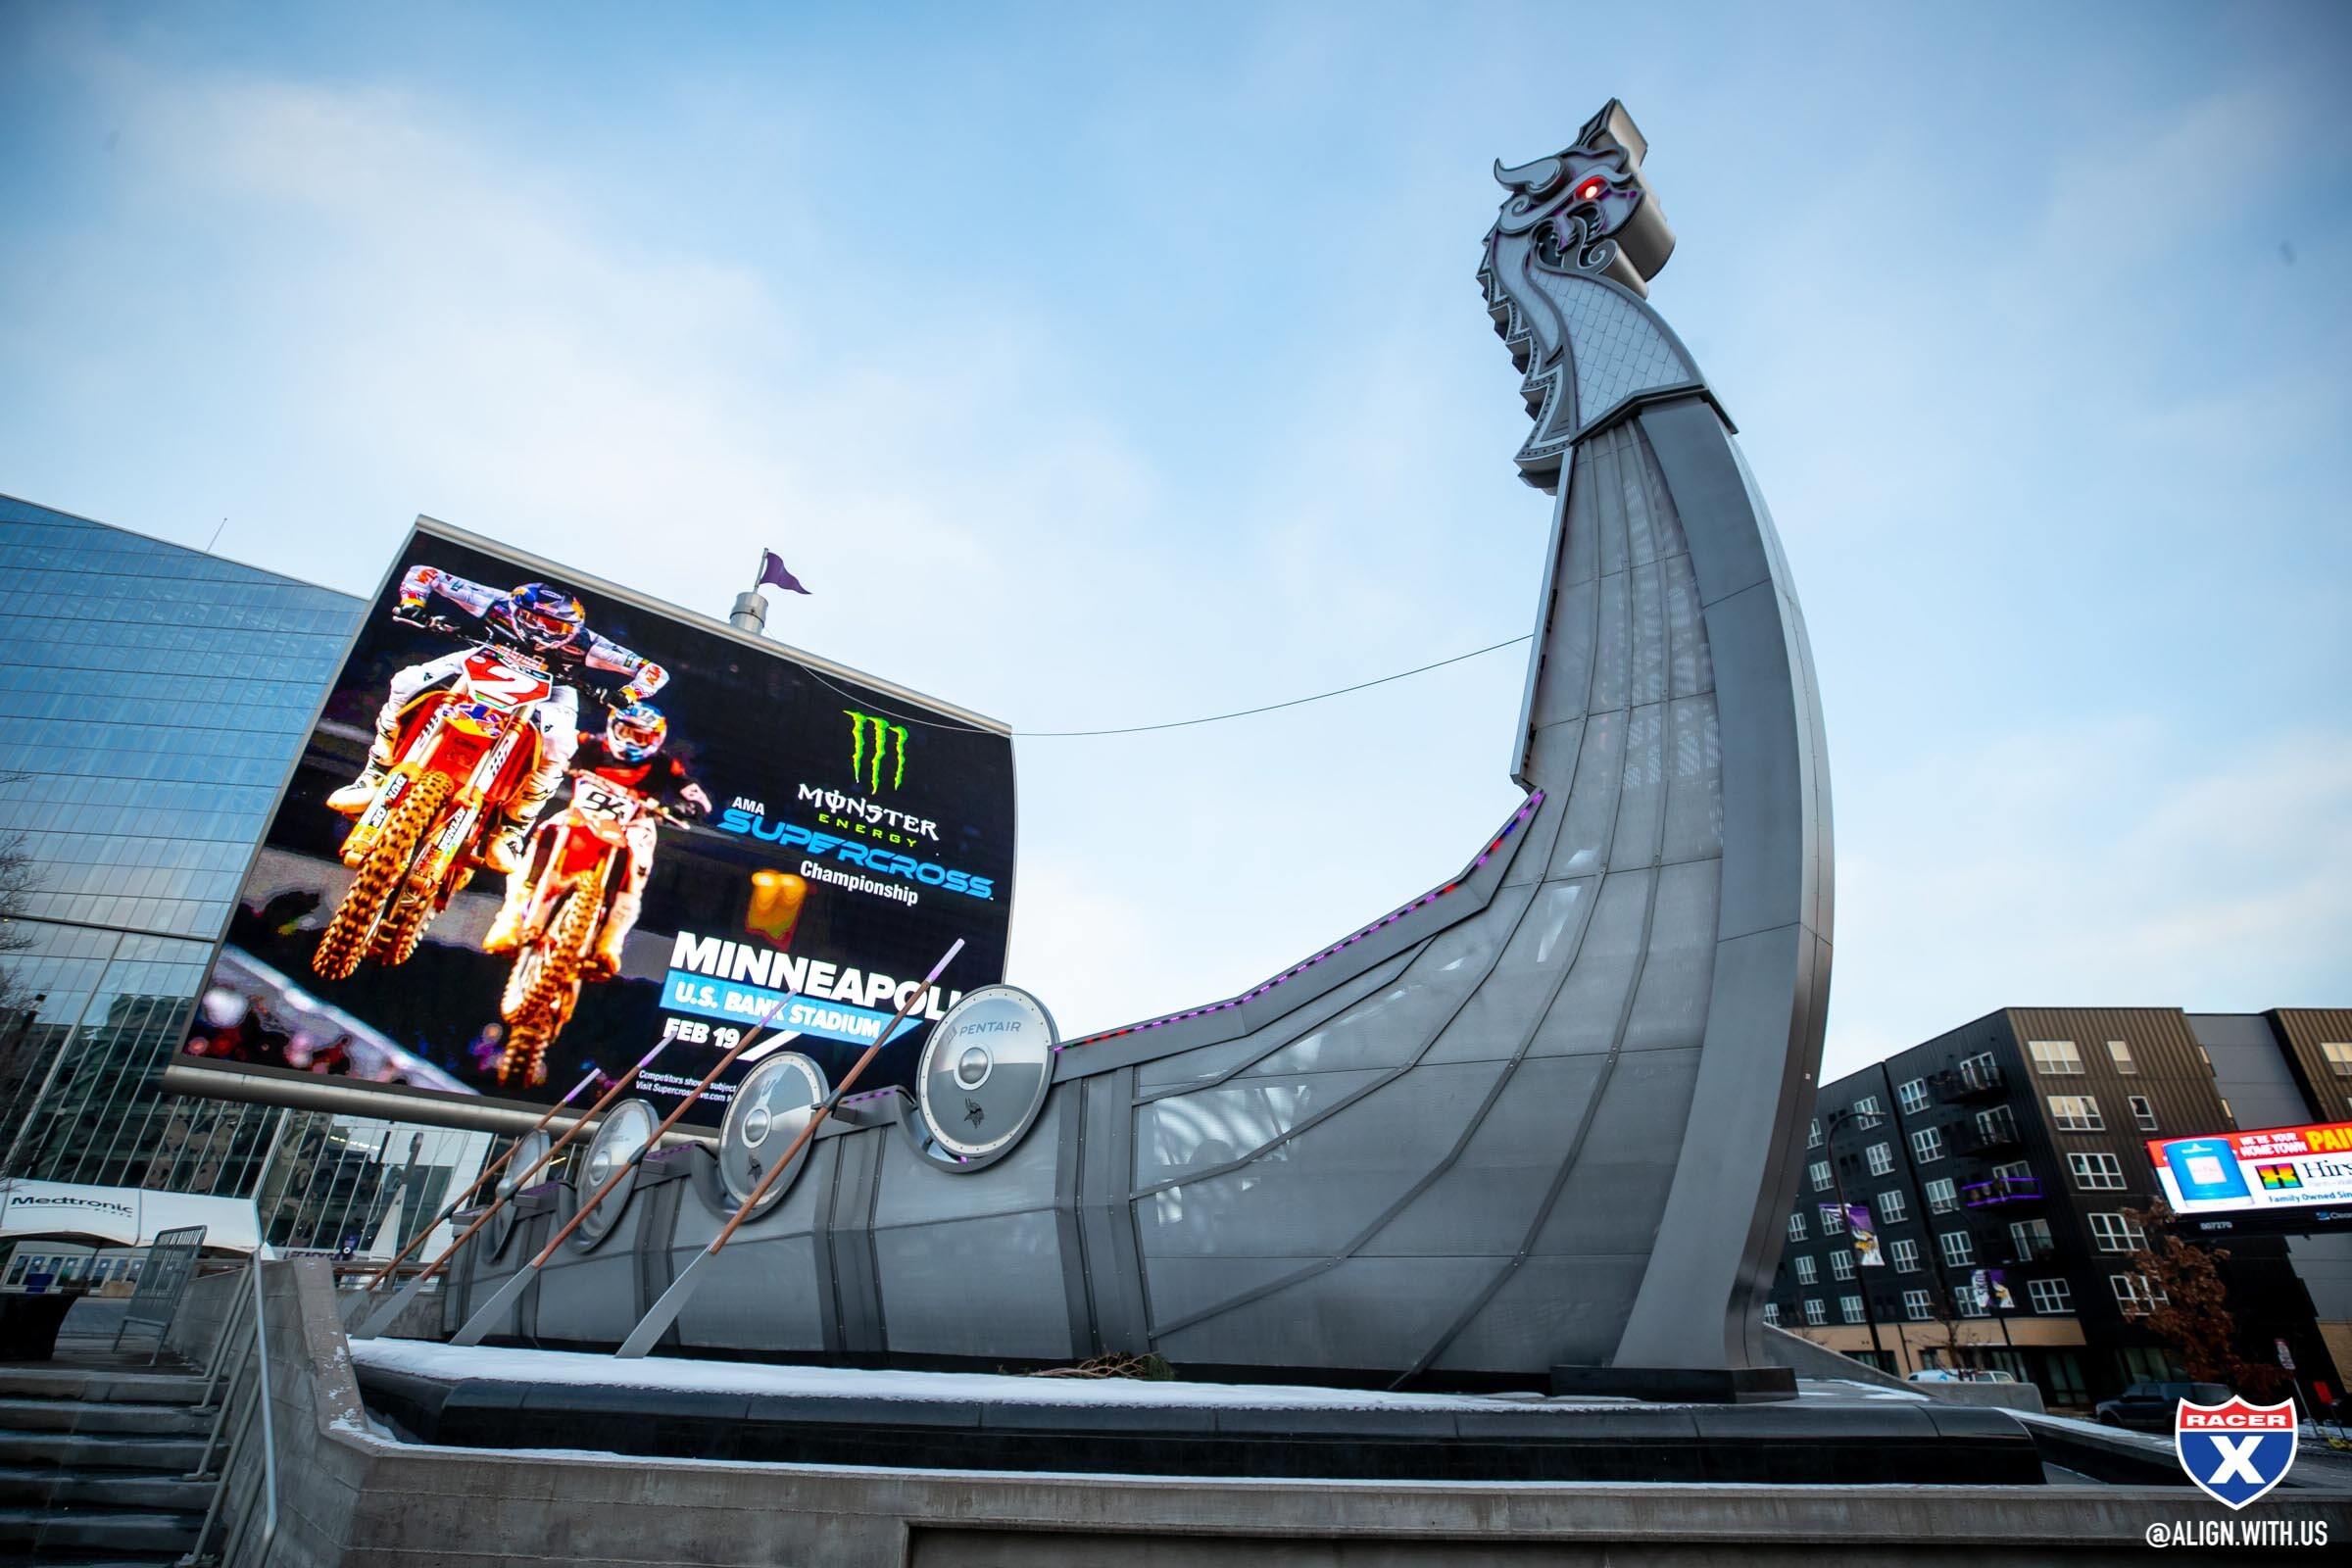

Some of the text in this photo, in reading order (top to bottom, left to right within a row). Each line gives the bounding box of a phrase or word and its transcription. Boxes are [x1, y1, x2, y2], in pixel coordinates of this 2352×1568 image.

[465, 665, 540, 706] 2
[731, 796, 766, 816] AMA
[797, 783, 940, 842] MONSTER
[818, 813, 918, 848] ENERGY
[716, 808, 995, 900] SUPERCROSS
[800, 860, 919, 906] Championship
[674, 981, 881, 1039] U.S. BANK STADIUM
[662, 1017, 740, 1050] FEB 19
[958, 1021, 1021, 1037] PENTAIR
[635, 1081, 652, 1091] Visit
[710, 1082, 737, 1093] subject
[2239, 1141, 2308, 1157] HOMETOWN
[11, 1197, 133, 1214] Medtronic
[2269, 1195, 2300, 1203] Family
[2302, 1192, 2336, 1200] Owned
